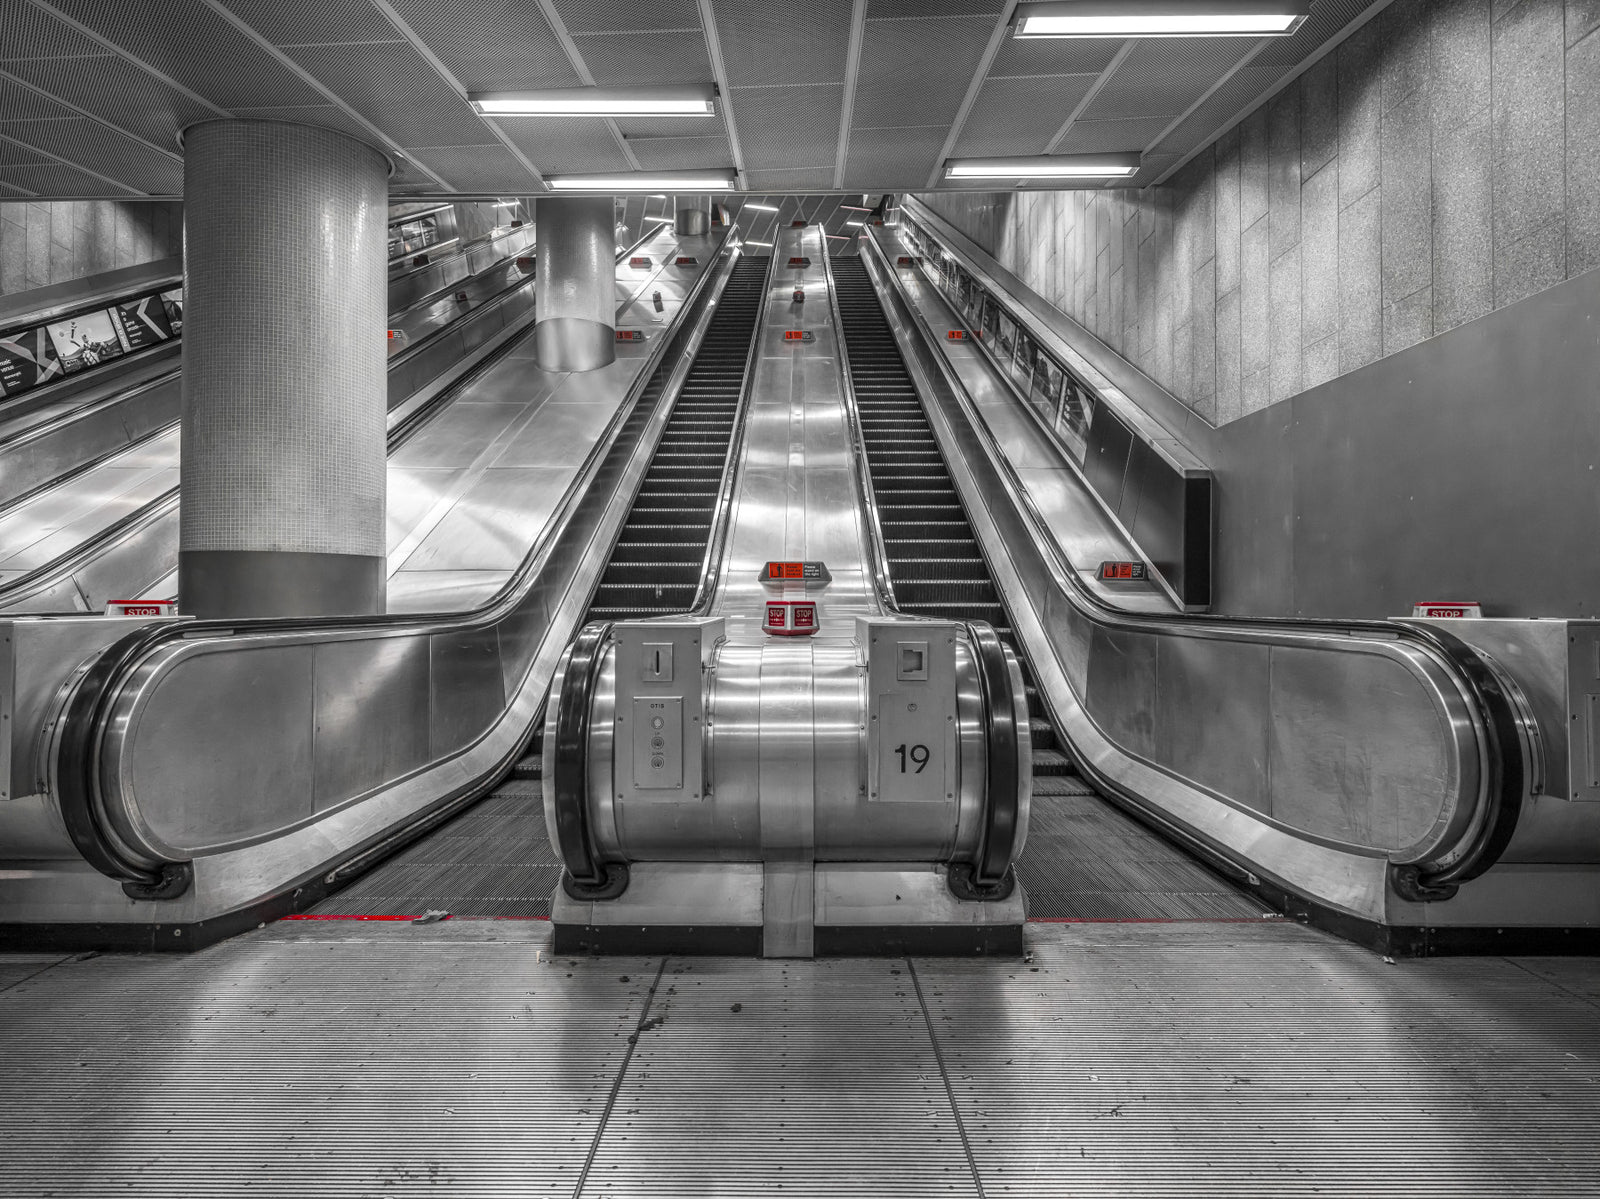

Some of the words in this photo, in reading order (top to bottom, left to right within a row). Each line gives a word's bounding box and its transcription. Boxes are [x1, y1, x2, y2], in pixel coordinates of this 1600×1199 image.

[128, 608, 156, 616] STOP
[769, 609, 784, 617] STOP
[796, 609, 812, 618] STOP
[895, 744, 930, 773] 19
